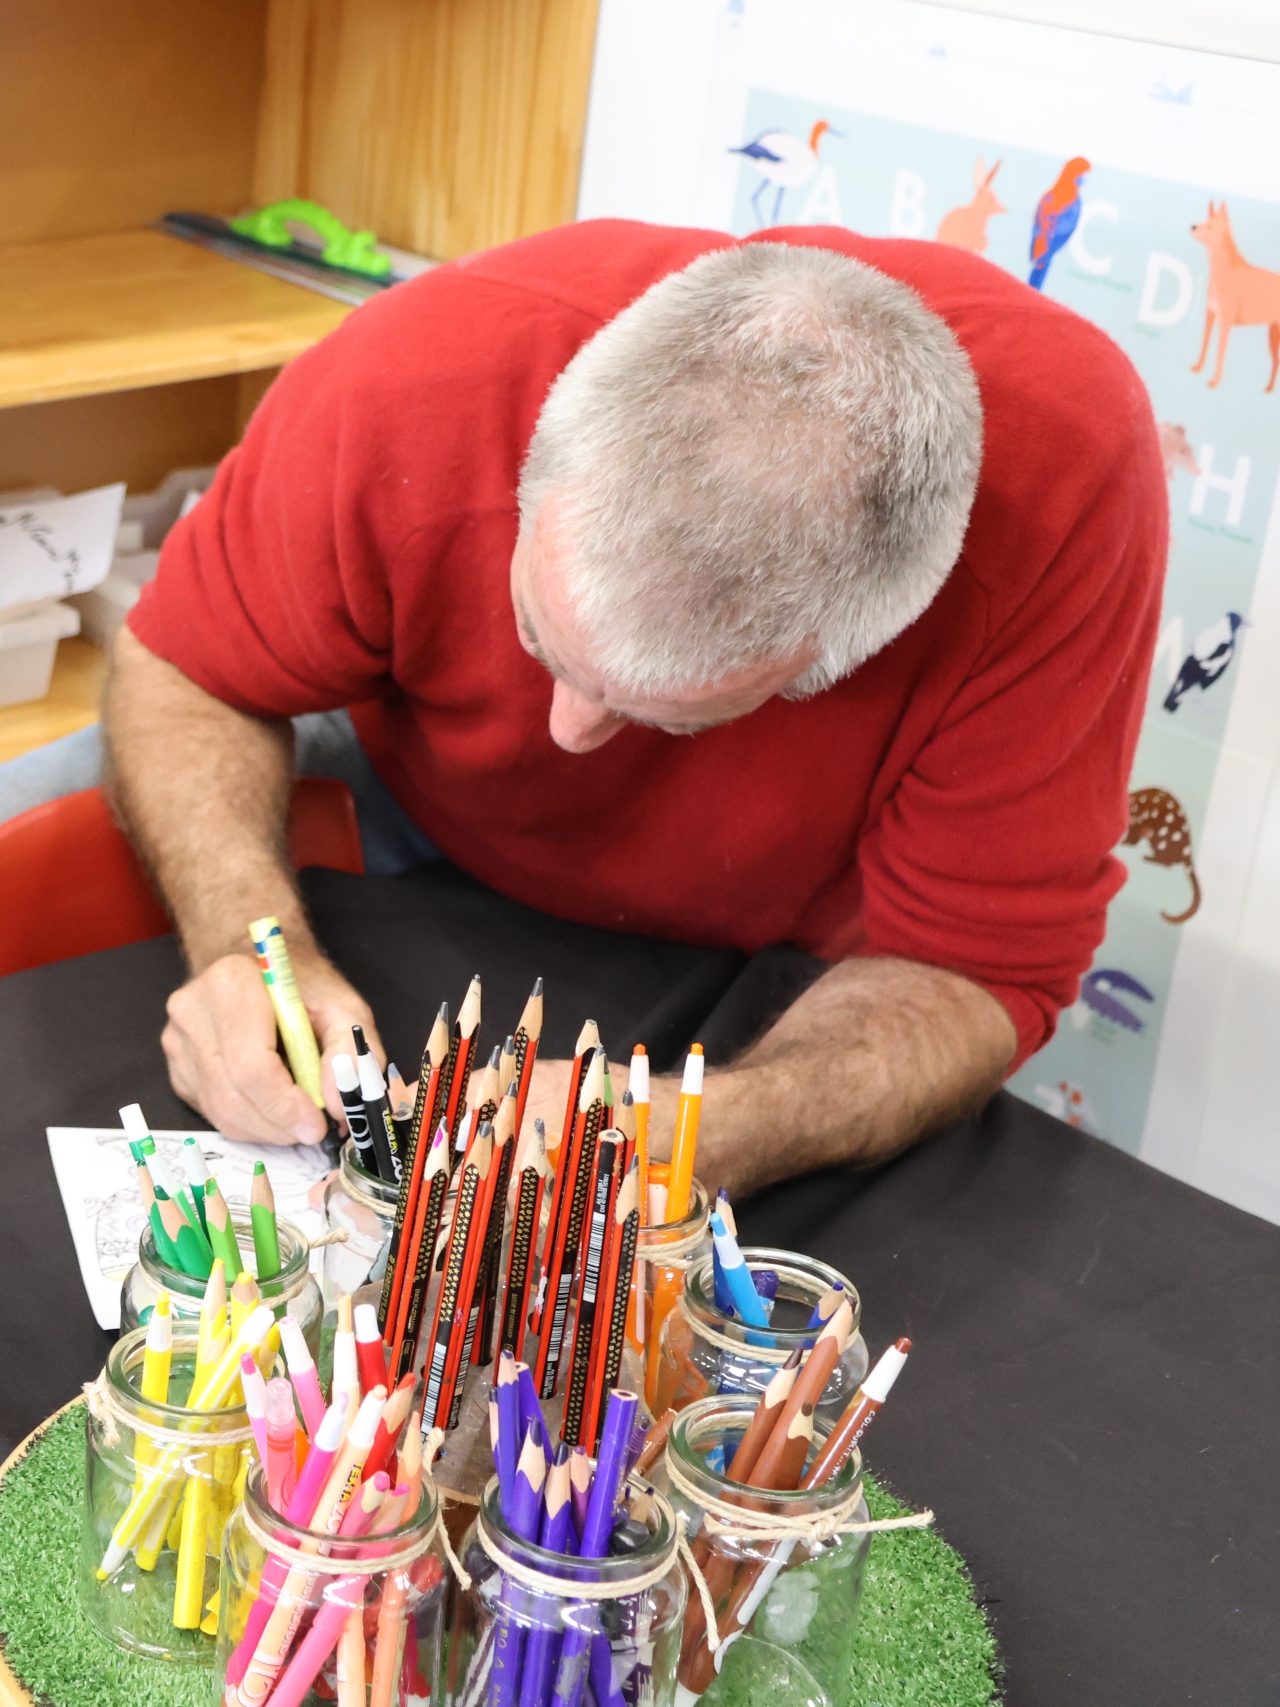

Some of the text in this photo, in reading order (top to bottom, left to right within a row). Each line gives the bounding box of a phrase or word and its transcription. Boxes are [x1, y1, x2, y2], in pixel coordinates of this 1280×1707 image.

[797, 164, 844, 226] A
[890, 168, 926, 237] B
[1069, 201, 1120, 275] C
[1137, 251, 1194, 326] D
[1189, 445, 1252, 527] H
